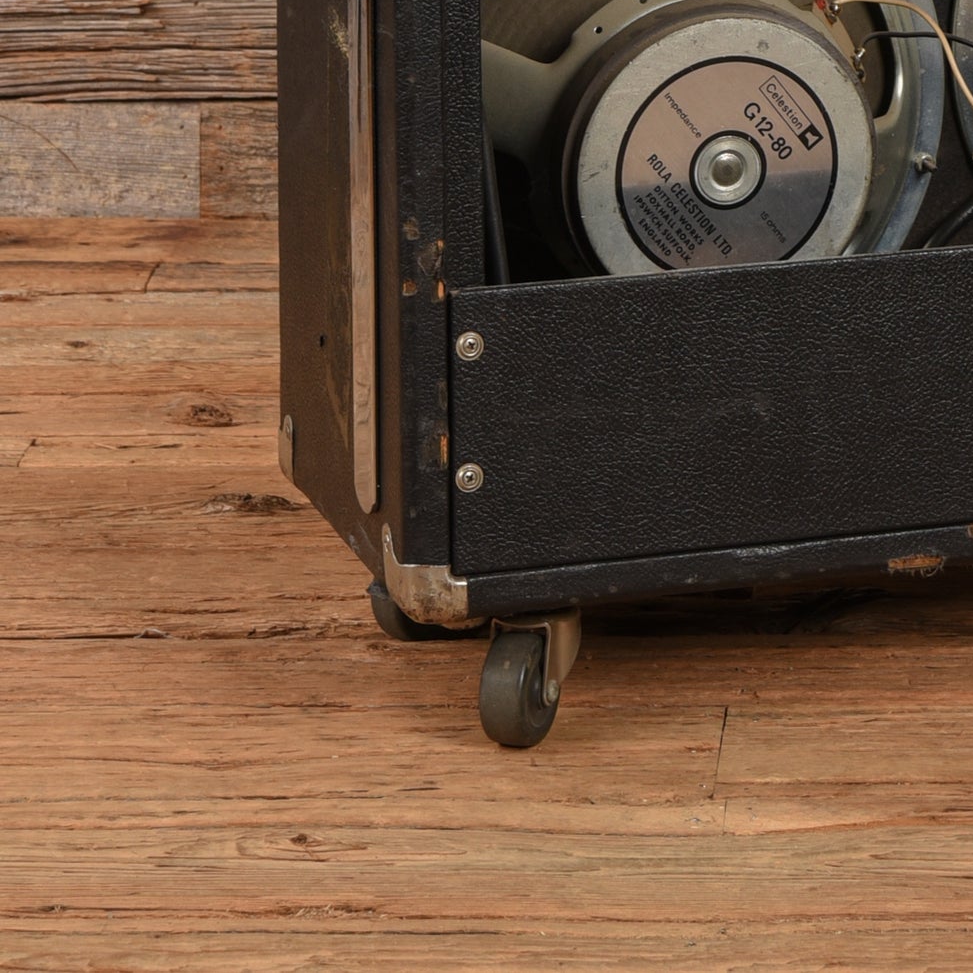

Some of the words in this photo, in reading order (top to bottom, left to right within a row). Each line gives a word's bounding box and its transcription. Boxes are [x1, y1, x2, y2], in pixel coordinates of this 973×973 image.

[664, 92, 701, 138] Impedance
[766, 83, 804, 130] Celestion
[646, 154, 672, 183] ROLA
[671, 183, 716, 236] CELESTION
[713, 233, 733, 259] LTD.
[646, 192, 675, 231] FOXHALL
[675, 227, 696, 255] ROAD,
[654, 185, 678, 215] DITTON
[679, 215, 704, 245] WORKS
[638, 218, 671, 257] ENGLAND
[661, 228, 691, 266] SUFFOLK,
